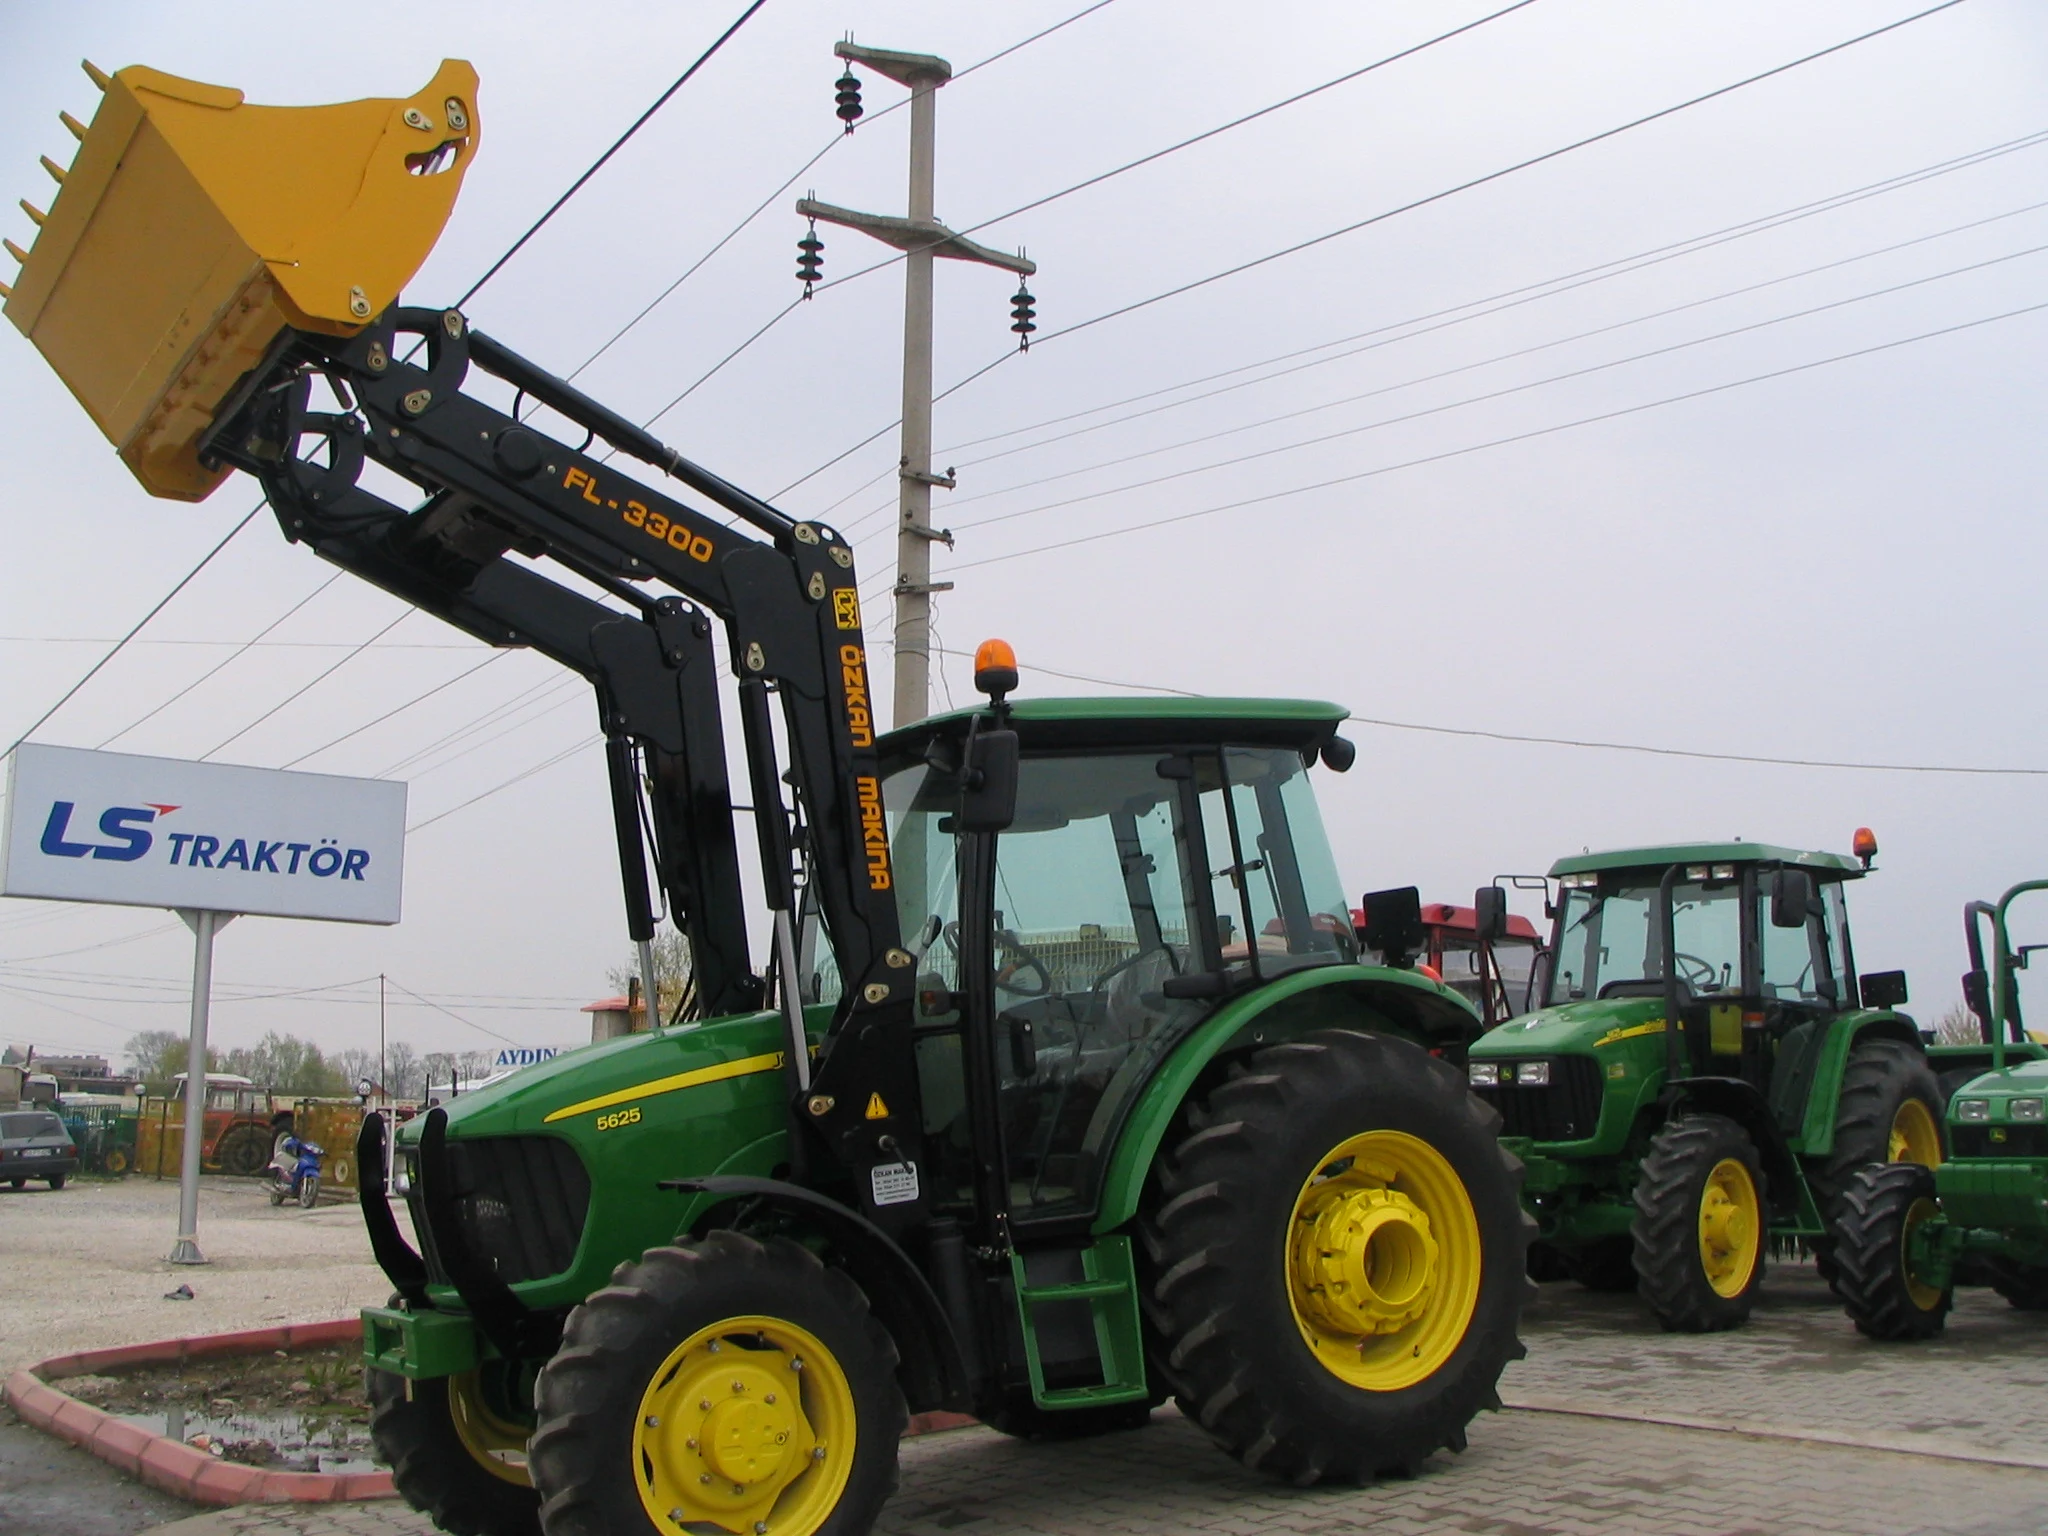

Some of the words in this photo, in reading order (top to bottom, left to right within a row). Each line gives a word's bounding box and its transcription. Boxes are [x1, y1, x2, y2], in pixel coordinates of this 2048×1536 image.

[40, 800, 157, 862] LS
[168, 832, 371, 882] TRAKTÖR
[495, 1047, 559, 1066] AYDIN
[596, 1107, 642, 1131] 5625
